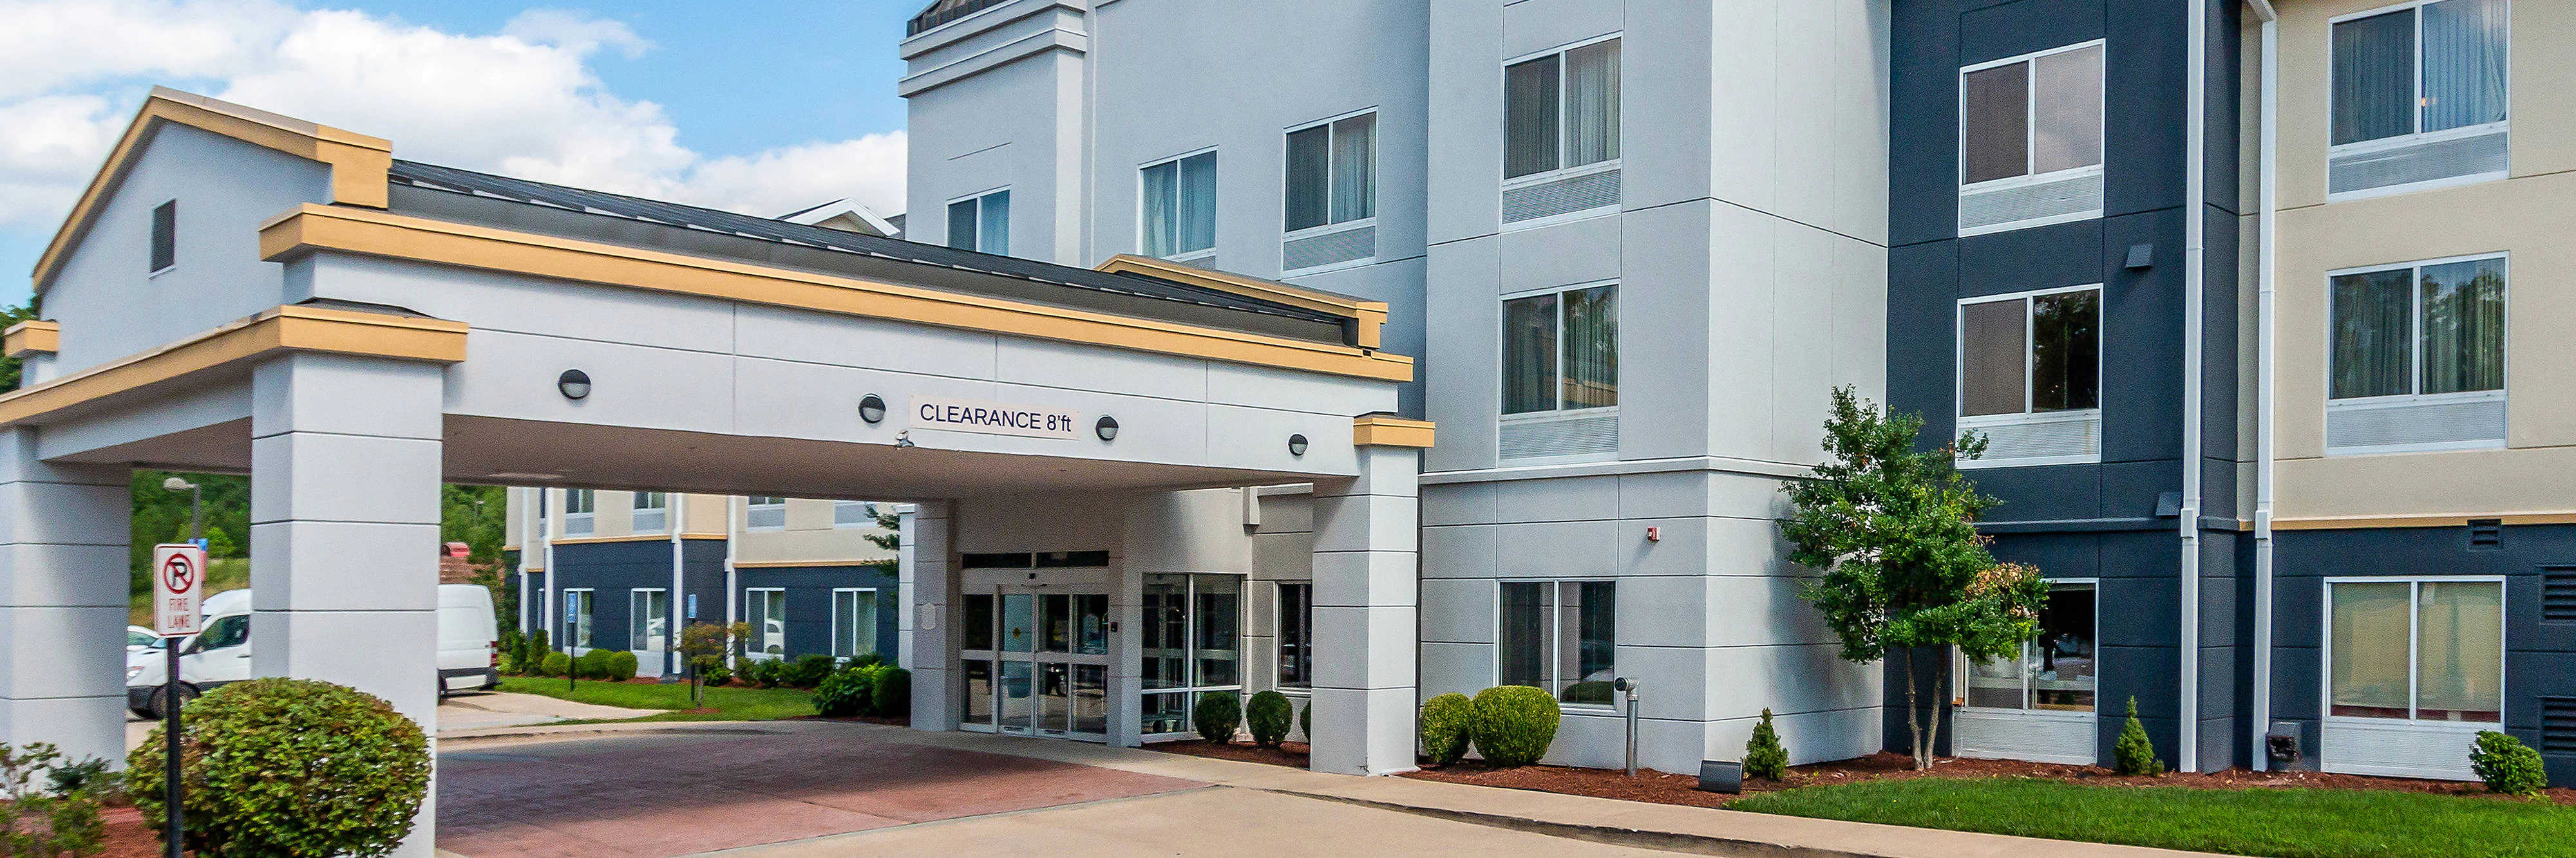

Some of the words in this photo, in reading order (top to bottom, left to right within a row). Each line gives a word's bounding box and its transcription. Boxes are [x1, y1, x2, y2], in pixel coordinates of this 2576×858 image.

[920, 404, 1041, 430] CLEARANCE
[1046, 414, 1072, 433] 8'ft
[169, 598, 189, 611] FIRE
[167, 614, 190, 629] LANE
